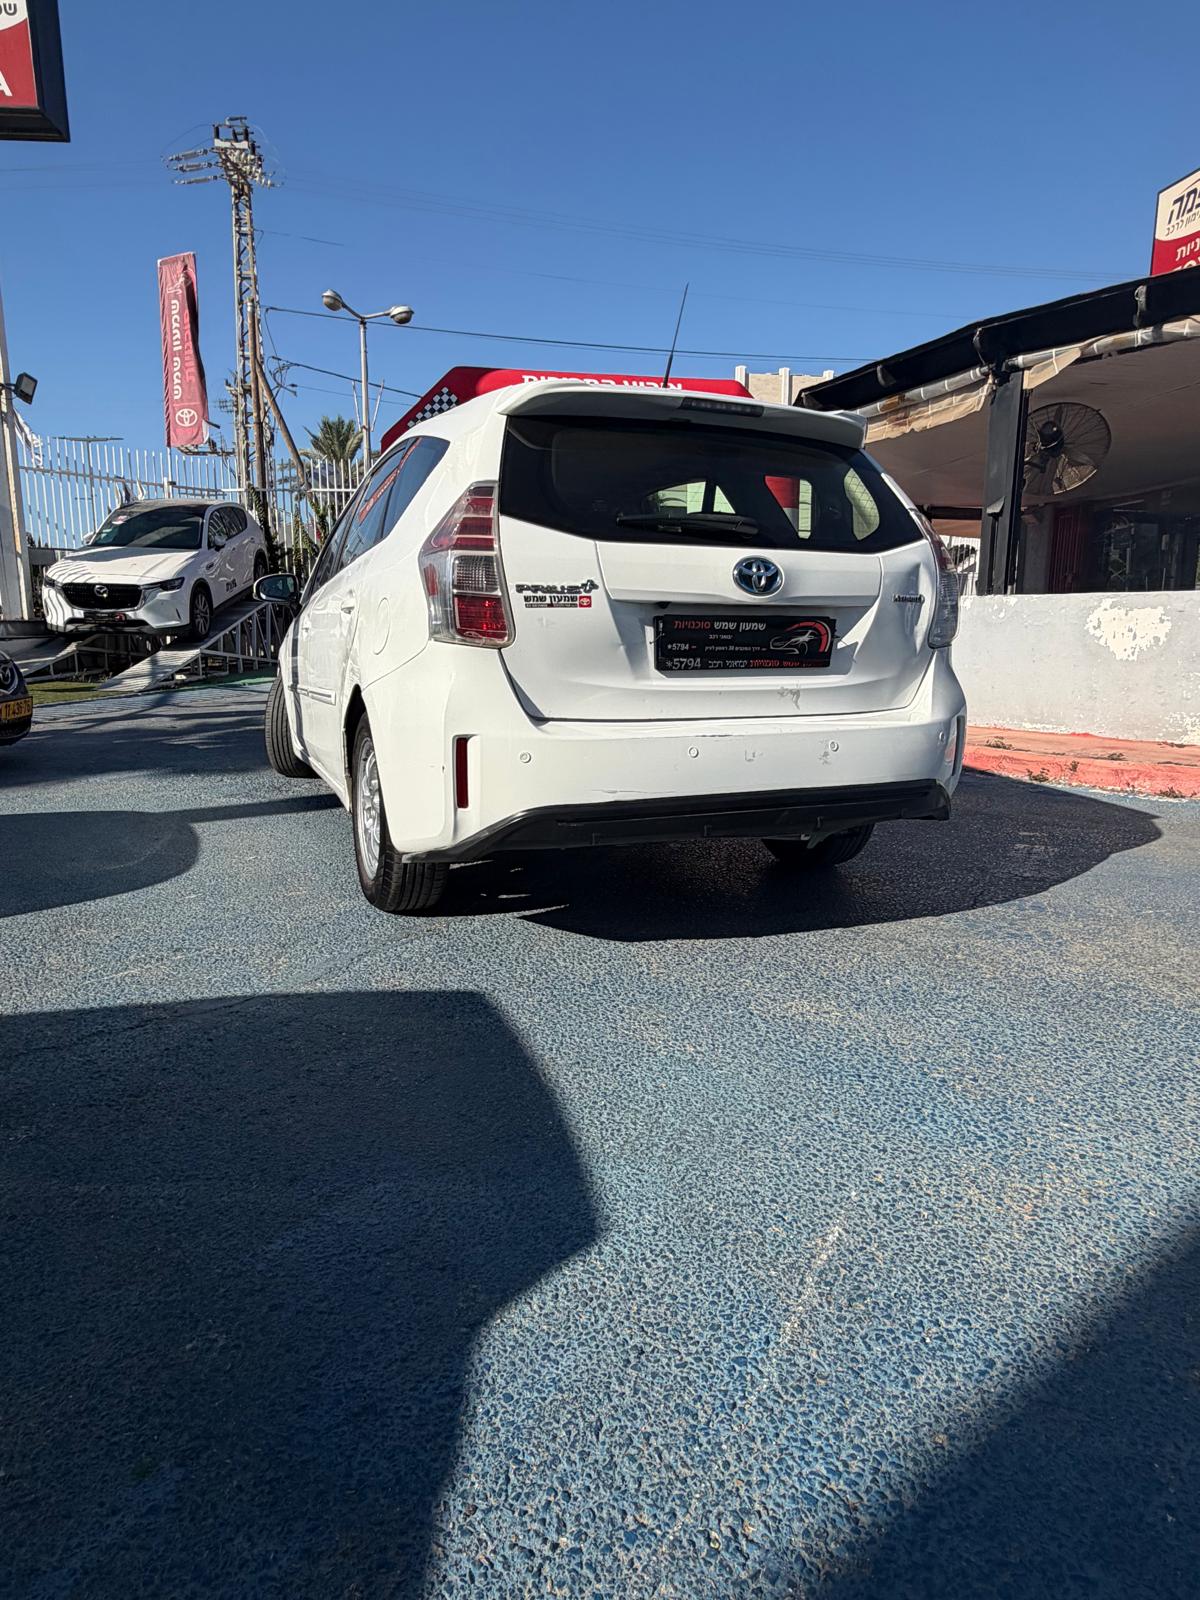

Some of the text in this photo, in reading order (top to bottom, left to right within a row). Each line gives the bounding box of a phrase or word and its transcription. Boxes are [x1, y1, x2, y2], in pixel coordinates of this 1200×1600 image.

[171, 299, 183, 401] שמעון שמש
[523, 595, 547, 603] שמש
[549, 595, 578, 606] שמעון
[713, 620, 737, 631] שמש
[739, 621, 767, 633] שמעון
